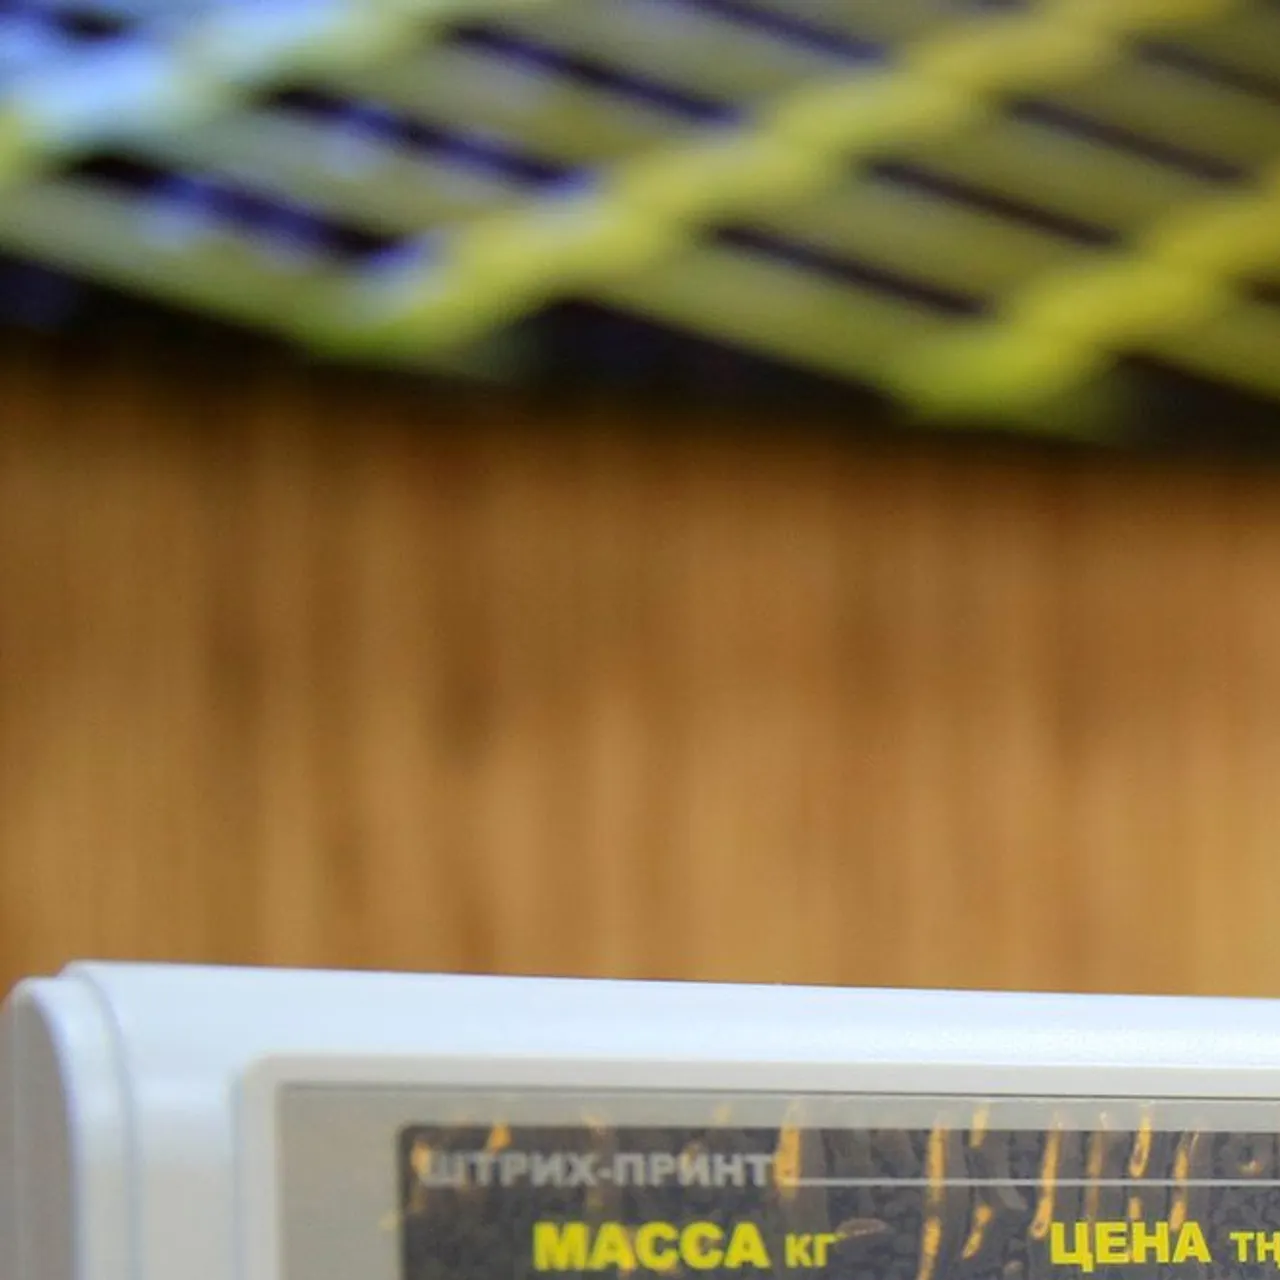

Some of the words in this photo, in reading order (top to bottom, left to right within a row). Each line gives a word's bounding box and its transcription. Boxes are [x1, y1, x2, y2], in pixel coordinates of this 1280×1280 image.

[420, 1151, 774, 1188] ШТРИХ-ПРИНТ
[533, 1222, 771, 1272] МАССА
[785, 1233, 840, 1268] кг
[1051, 1220, 1212, 1273] ЦЕНА
